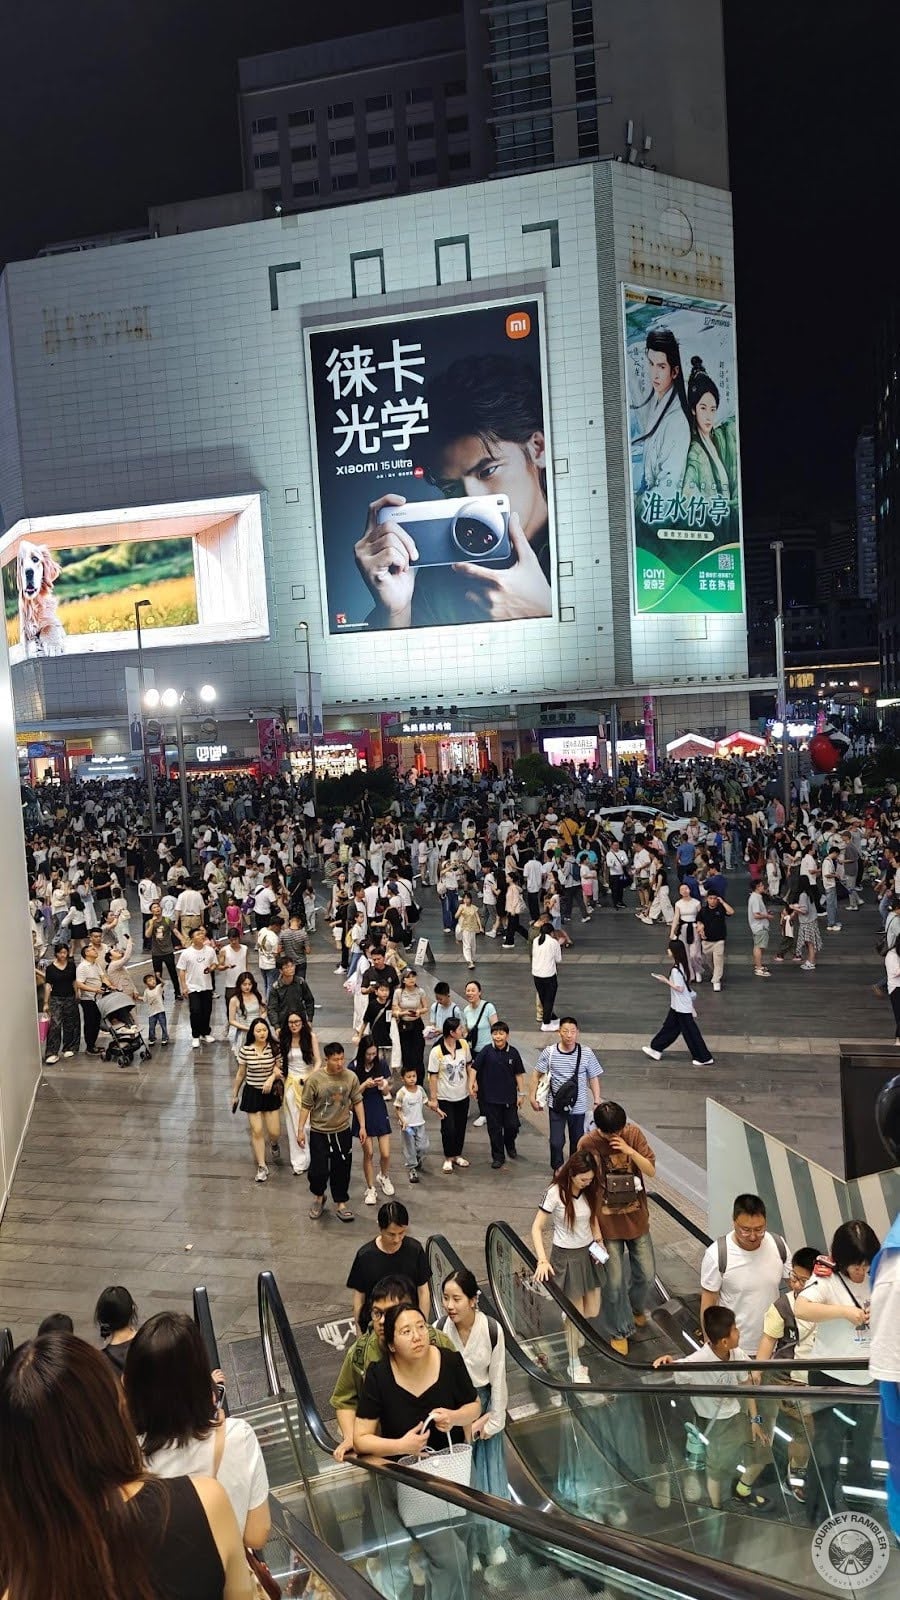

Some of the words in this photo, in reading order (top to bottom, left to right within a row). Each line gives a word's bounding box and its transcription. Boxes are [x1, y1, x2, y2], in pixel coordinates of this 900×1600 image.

[325, 338, 426, 401] 徕卡
[332, 396, 430, 459] 光学
[380, 462, 391, 471] 15
[391, 459, 413, 470] Ultra
[642, 491, 729, 527] 淮水竹亭
[642, 568, 665, 579] iQIYI
[643, 579, 665, 590] 爱奇艺
[699, 579, 735, 590] 正在热播
